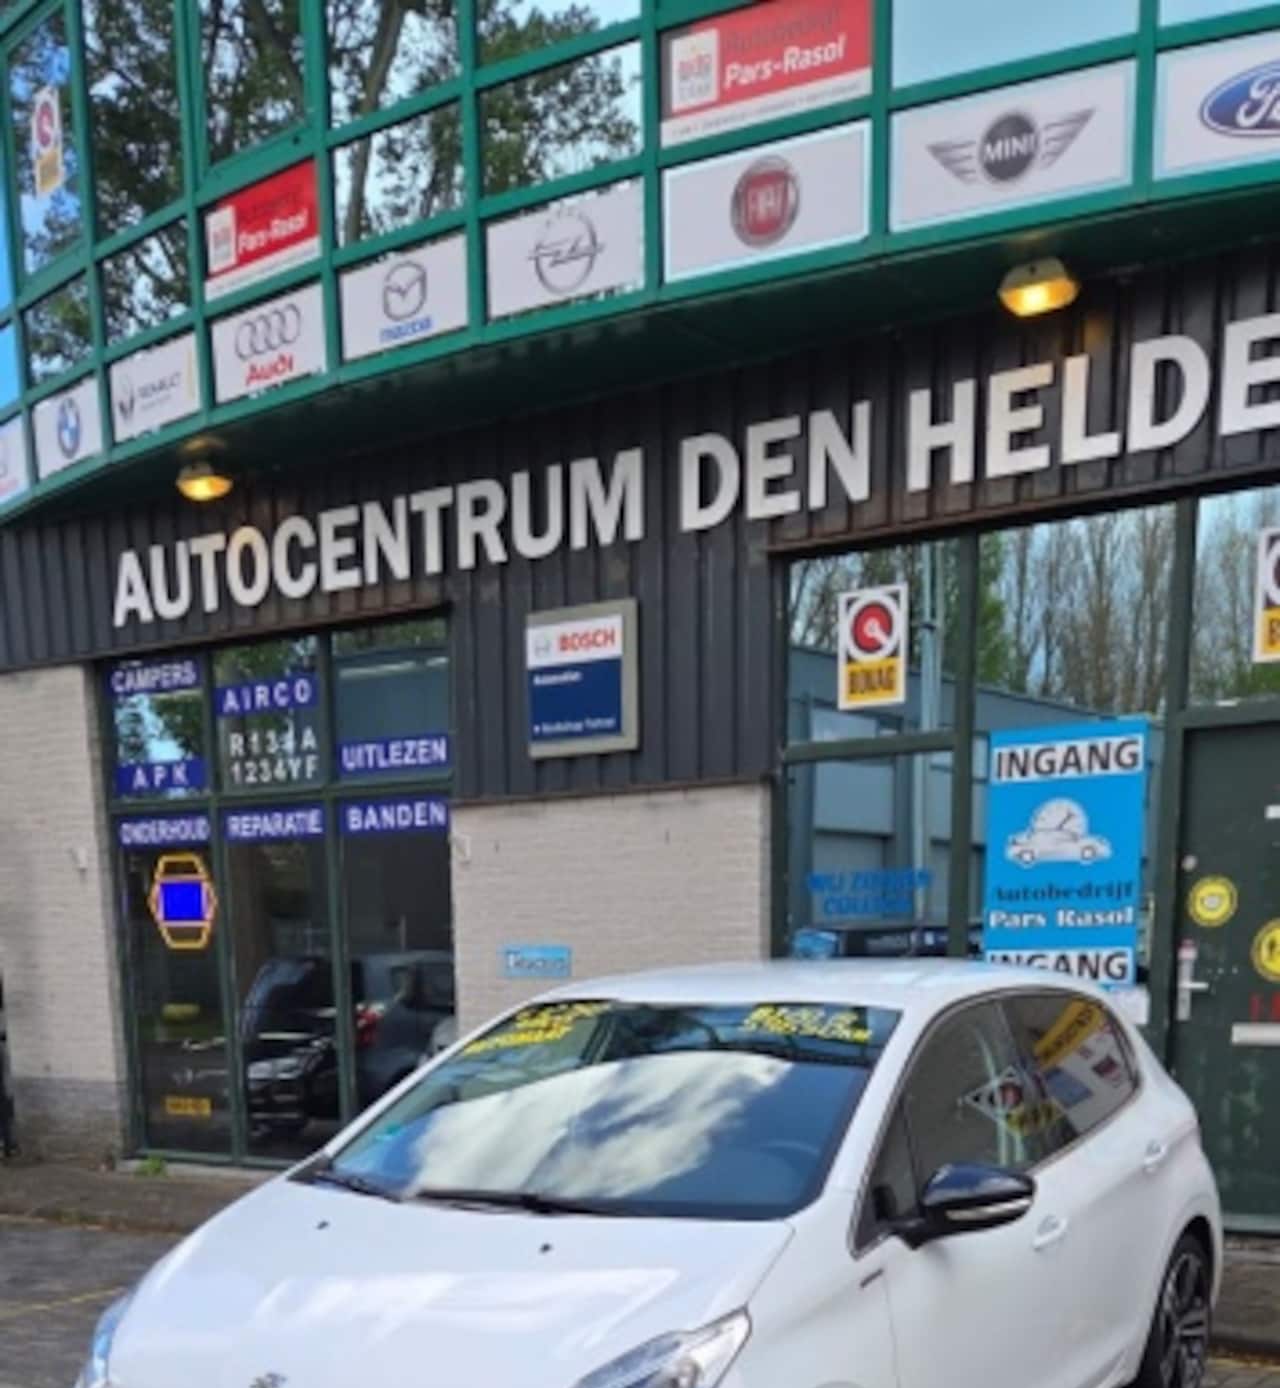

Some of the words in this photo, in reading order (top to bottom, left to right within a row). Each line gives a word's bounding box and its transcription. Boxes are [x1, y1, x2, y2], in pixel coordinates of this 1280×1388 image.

[724, 33, 847, 89] Pars-Rasol
[982, 132, 1037, 163] MINI
[245, 354, 294, 386] Audi
[114, 447, 645, 628] AUTOCENTRUM
[680, 400, 871, 532] DEN
[559, 626, 616, 652] BOSCH
[111, 660, 197, 692] CAMPERS
[222, 677, 312, 713] AIRCO
[342, 738, 447, 769] UITLEZEN
[997, 740, 1138, 779] INGANG
[132, 762, 188, 790] APK
[121, 816, 210, 843] ONDERHOUD
[227, 808, 323, 837] REPARATIE
[346, 801, 446, 830] BANDEN
[989, 909, 1047, 929] Pars
[1056, 905, 1134, 928] Rasol
